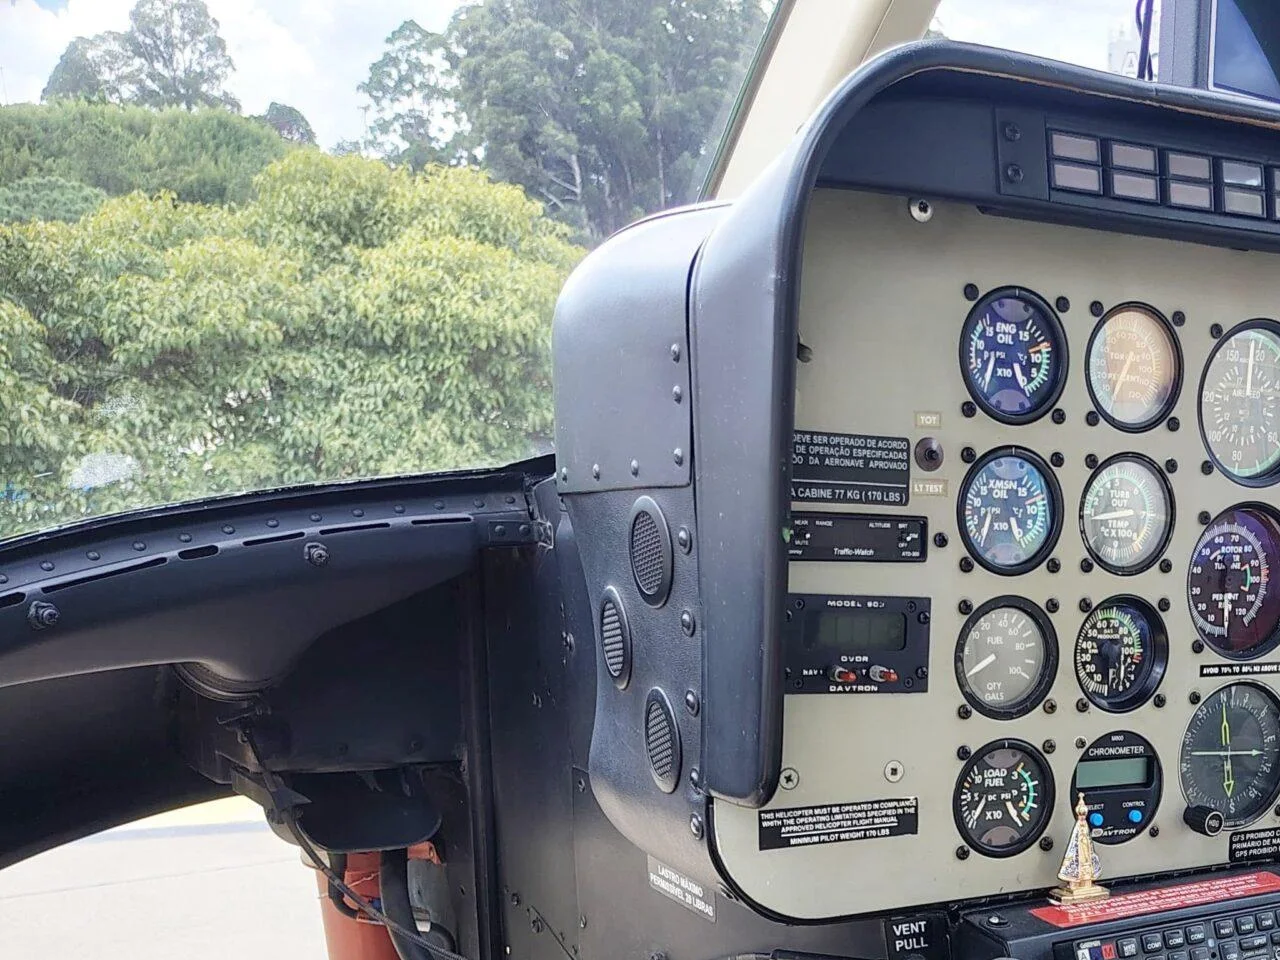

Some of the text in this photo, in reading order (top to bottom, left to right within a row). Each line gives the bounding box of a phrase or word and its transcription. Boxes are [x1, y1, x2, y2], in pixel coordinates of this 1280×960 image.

[996, 322, 1017, 334] ENG
[997, 334, 1014, 345] OIL
[996, 368, 1013, 378] X10
[813, 435, 828, 444] SER
[830, 437, 865, 447] OPERADO
[867, 439, 876, 448] DE
[878, 440, 907, 450] ACORDO
[796, 445, 907, 460] DE OPERAÇÃO ESPECIFICADAS
[809, 457, 820, 465] DA
[825, 458, 864, 468] AERONAVE
[869, 462, 907, 470] APROVADO
[914, 484, 943, 493] LT TEST
[988, 480, 1017, 490] XMSN
[798, 488, 832, 499] CABINE
[835, 490, 844, 498] 77
[846, 490, 860, 499] KG
[992, 489, 1008, 499] OIL
[1110, 490, 1130, 499] TURB
[1111, 499, 1128, 507] OUT
[993, 522, 1009, 531] X10
[1108, 520, 1129, 528] TEMP
[834, 548, 874, 556] Traffic-Watch
[1221, 546, 1243, 554] ROTOR
[827, 600, 862, 608] MODEL
[987, 636, 1004, 645] FUEL
[829, 684, 878, 692] DAVTRON
[986, 682, 1002, 691] QTY
[985, 693, 1004, 701] GALS
[1089, 746, 1145, 756] CHRONOMETER
[984, 769, 1007, 778] LOAD
[984, 778, 1004, 787] FUEL
[761, 812, 774, 820] THIS
[776, 809, 813, 818] HELICOPTER
[842, 804, 872, 813] OPERATED
[880, 800, 916, 809] COMPLIANCE
[986, 810, 1002, 820] X10
[796, 815, 829, 824] OPERATING
[831, 811, 866, 820] LIMITATIONS
[867, 809, 896, 817] SPECIFIED
[781, 816, 898, 833] APPROVED HELICOPTER FLIGHT MANUAL
[790, 836, 820, 845] MINIMUM
[820, 834, 839, 842] PILOT
[840, 832, 865, 840] WEIGHT
[1246, 830, 1275, 840] PROIBIDO
[1232, 839, 1261, 850] PRIMÁRIO
[1235, 849, 1248, 858] GPS
[1249, 846, 1277, 856] PROIBIDO
[658, 864, 680, 885] LASTRO
[693, 896, 714, 917] LIBRAS
[893, 921, 927, 936] VENT
[895, 937, 929, 952] PULL
